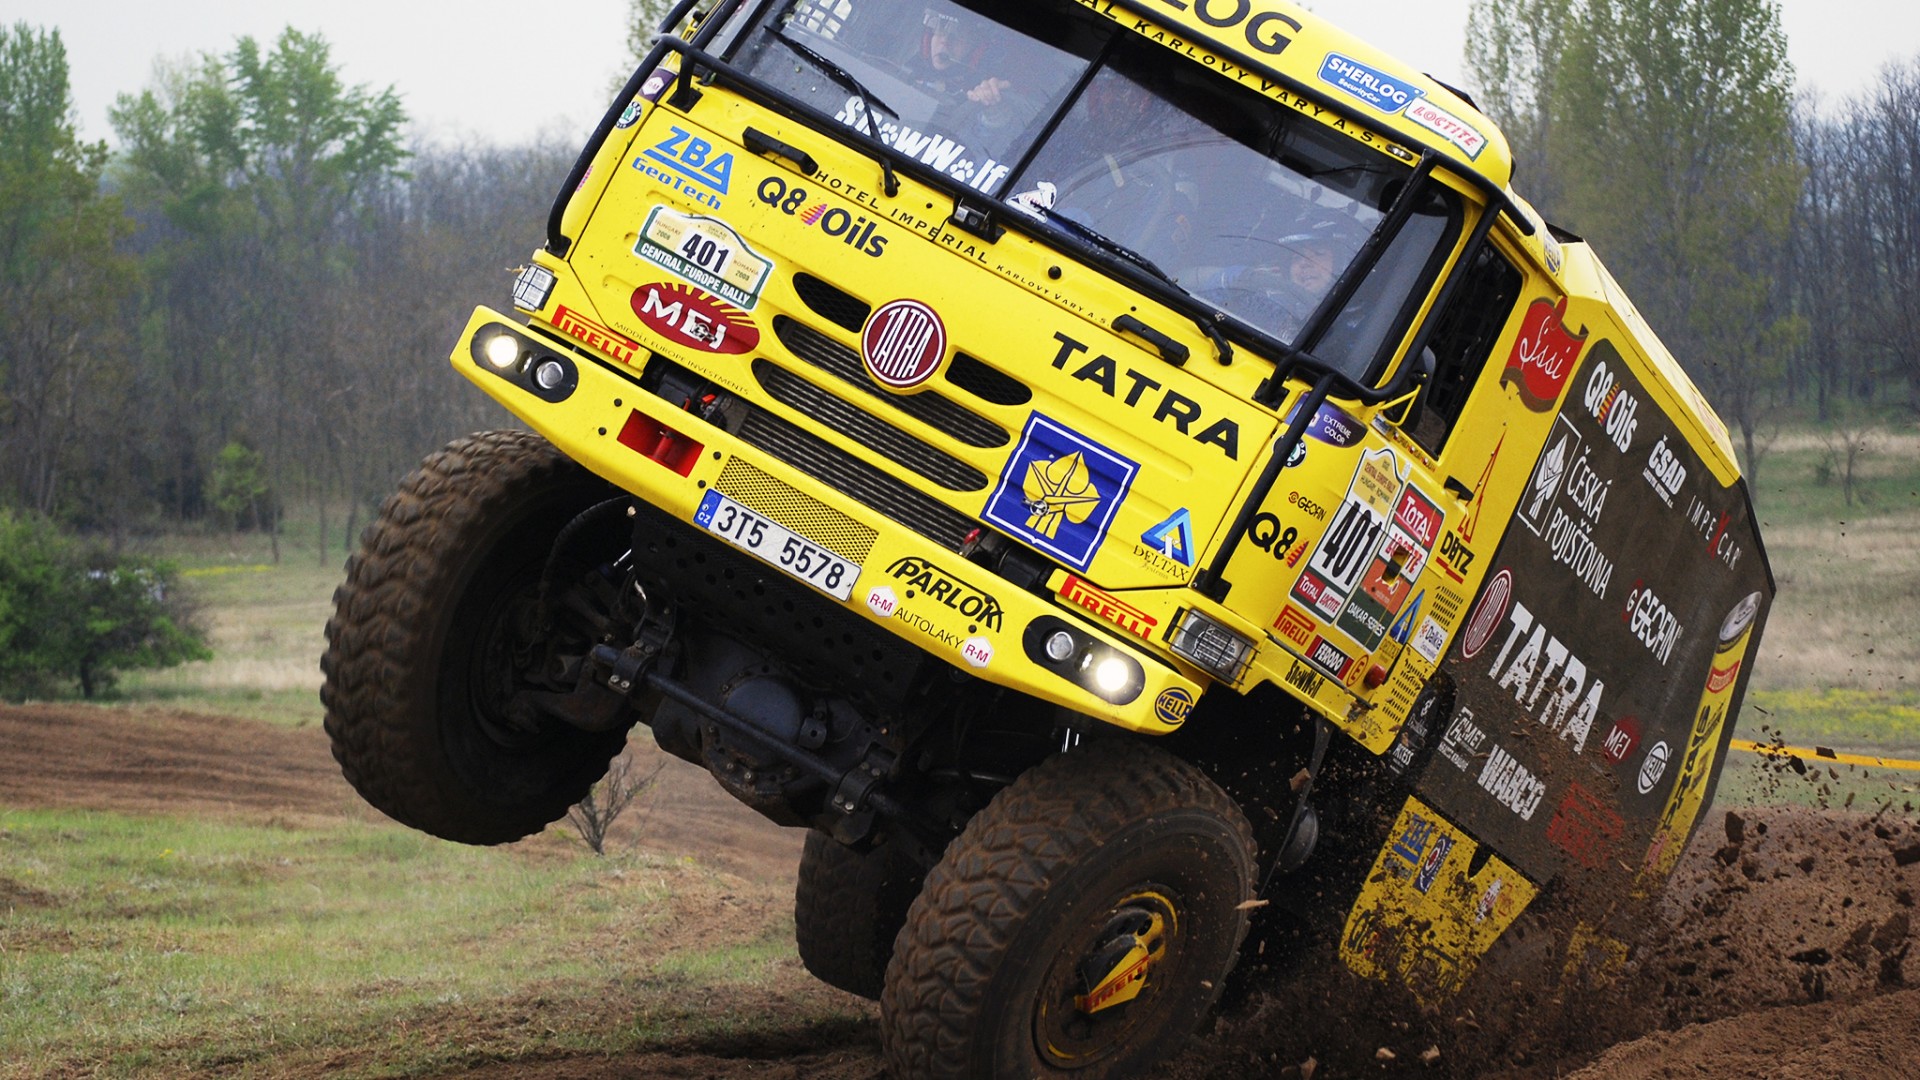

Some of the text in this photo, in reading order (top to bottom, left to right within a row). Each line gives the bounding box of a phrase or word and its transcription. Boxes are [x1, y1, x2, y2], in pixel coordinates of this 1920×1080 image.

[1133, 19, 1249, 80] KARLOVY
[1259, 74, 1325, 118] VARY
[1333, 118, 1381, 148] A.S.
[1327, 57, 1408, 104] SHERLOG
[1337, 78, 1381, 104] SecurityCar
[1413, 105, 1478, 146] LOCTITE
[632, 156, 722, 210] GeoTech
[648, 126, 735, 195] ZBA
[756, 176, 889, 258] Q8 Oils
[815, 170, 880, 209] HOTEL
[891, 208, 988, 264] IMPERIAL
[996, 264, 1050, 294] KARLOVY
[1055, 293, 1085, 313] VARY
[640, 242, 751, 305] CENTRAL EUROPE RALLY
[682, 233, 730, 273] 401
[551, 304, 639, 365] PIRELLI
[641, 288, 727, 350] MEI
[871, 306, 935, 378] TATRA
[614, 321, 749, 395] MIDDLE EUROPE INVESTMENTS
[1051, 331, 1240, 462] TATRA
[1323, 414, 1352, 439] EXTREME
[1584, 361, 1638, 453] Q8 Oils
[1324, 426, 1346, 446] COLOR
[1648, 434, 1687, 495] ČSAD
[1297, 496, 1327, 522] GEOFIN
[1567, 445, 1613, 524] ČESKÁ
[697, 511, 711, 525] CZ
[717, 505, 847, 590] 3T5 5578
[1248, 511, 1299, 560] Q8
[1322, 500, 1383, 587] 401
[1402, 495, 1431, 542] TOTAL
[896, 558, 1004, 627] PARLOK
[1133, 544, 1189, 582] DELTAX
[1299, 575, 1320, 601] TOTAL
[870, 593, 989, 663] R-M AUTOLAKY R-M
[1058, 573, 1158, 641] PIRELLI
[1273, 604, 1316, 647] PIRELLI
[1347, 602, 1369, 624] DAKAR
[1630, 588, 1682, 666] GEOFIN
[1314, 642, 1345, 672] FERODO
[1488, 601, 1605, 755] TATRA
[1158, 693, 1193, 721] HELLA
[1603, 724, 1632, 760] MEI
[1477, 743, 1547, 822] WABCO
